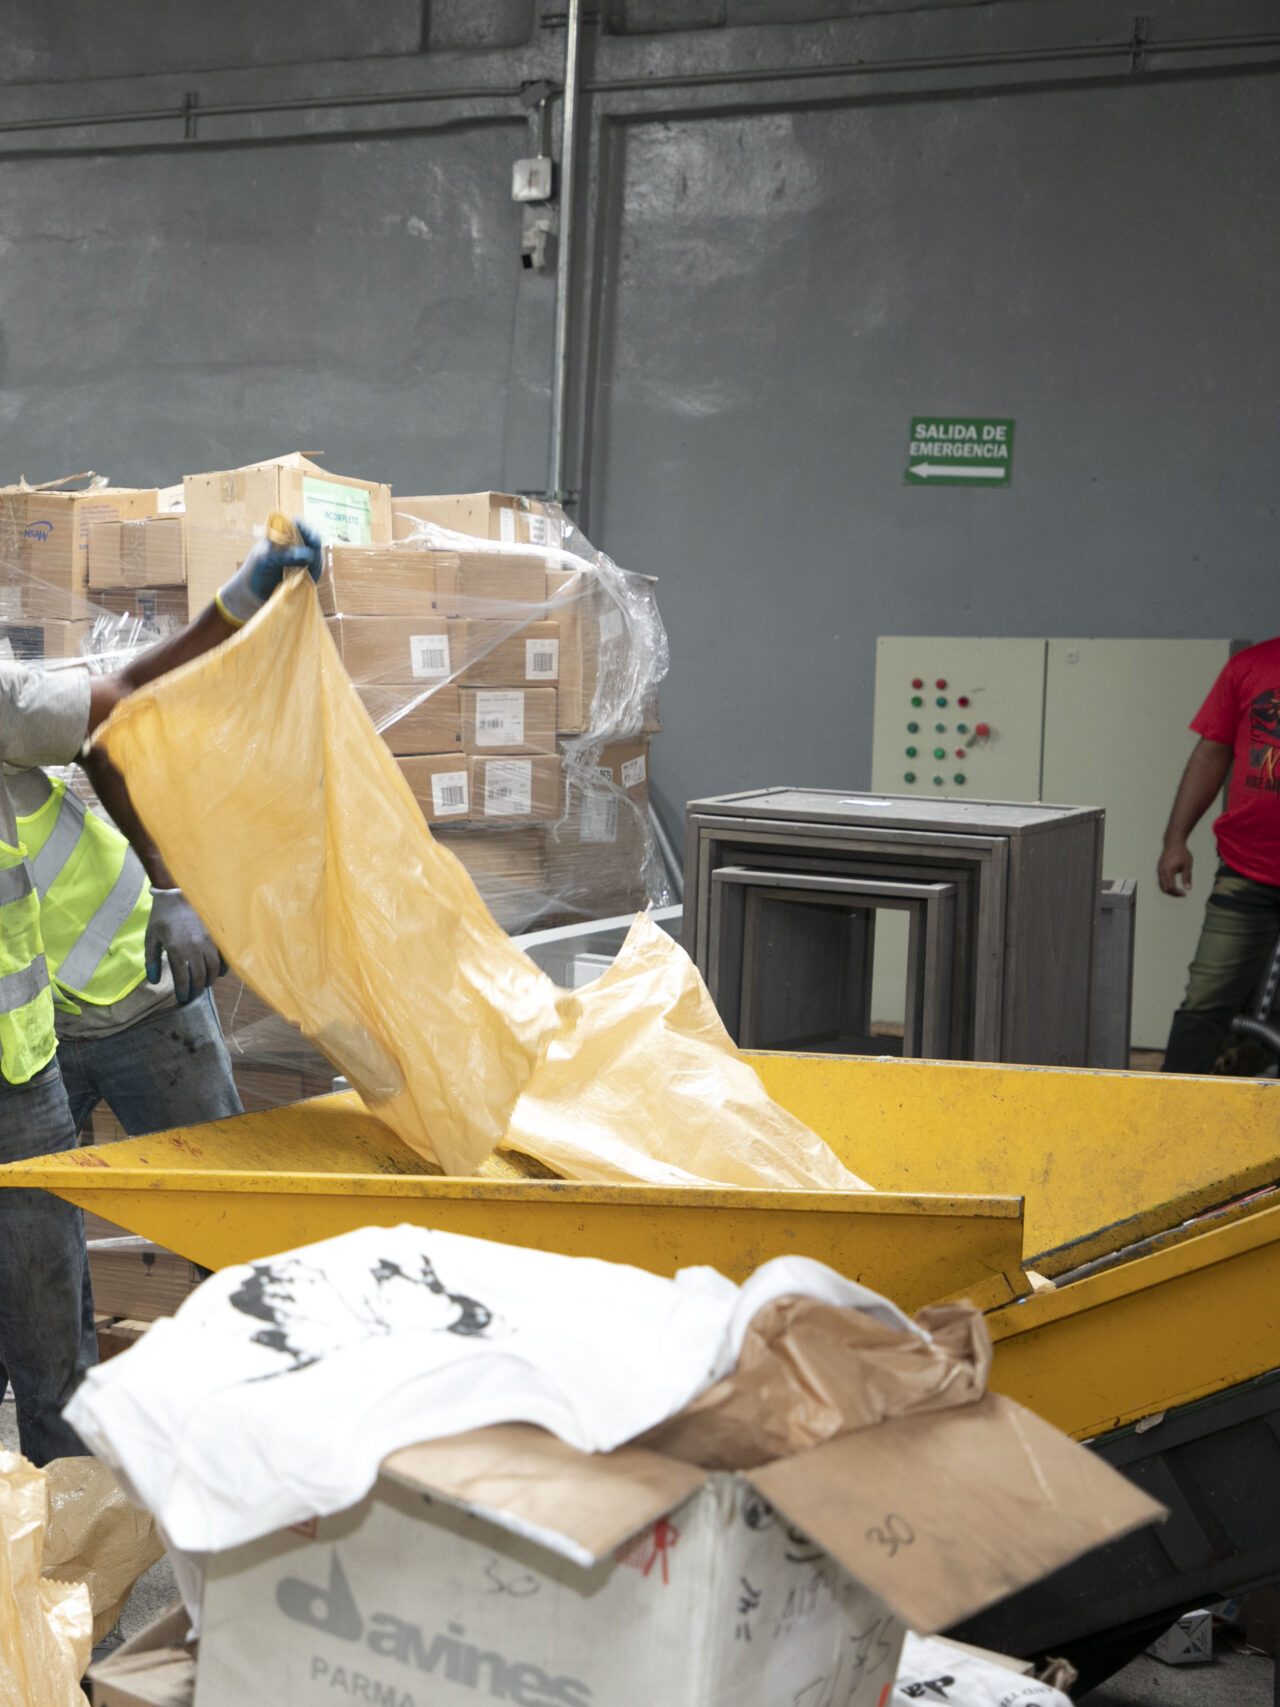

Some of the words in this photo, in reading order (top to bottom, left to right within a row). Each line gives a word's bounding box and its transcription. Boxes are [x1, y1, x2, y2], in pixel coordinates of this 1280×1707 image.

[915, 424, 978, 440] SALIDA
[983, 425, 1008, 441] DE
[909, 441, 1009, 458] EMERGENCIA
[324, 511, 361, 526] INCOMPLETO
[864, 1513, 916, 1558] 30
[275, 1543, 593, 1706] davines
[310, 1655, 416, 1707] PARMA
